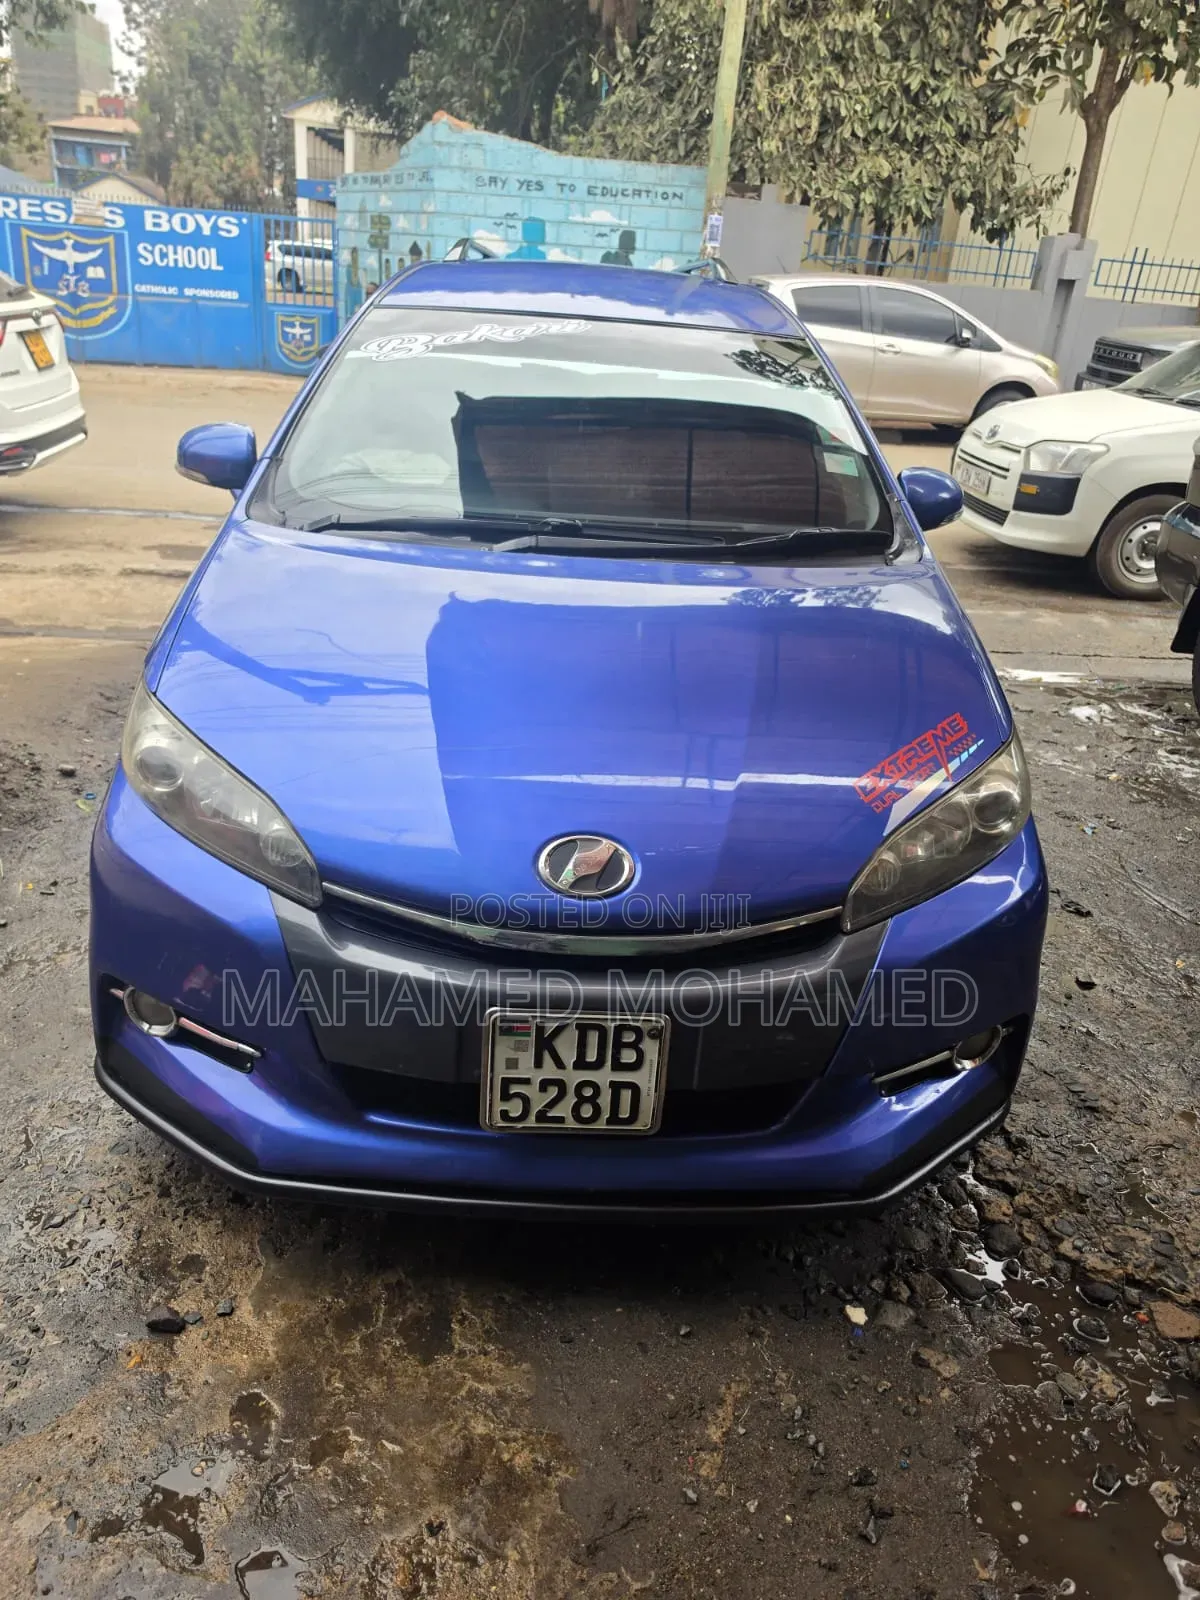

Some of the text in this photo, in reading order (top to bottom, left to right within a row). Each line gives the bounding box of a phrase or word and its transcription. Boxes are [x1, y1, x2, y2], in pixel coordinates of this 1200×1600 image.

[475, 175, 684, 201] SAY YES TO EDUCATION
[137, 242, 224, 271] SCHOOL
[134, 284, 240, 300] CATHOLIC SPONSORED
[853, 712, 969, 803] EXTREME
[870, 790, 903, 814] DUAL
[533, 1020, 645, 1072] KDB
[499, 1076, 641, 1126] 528D
